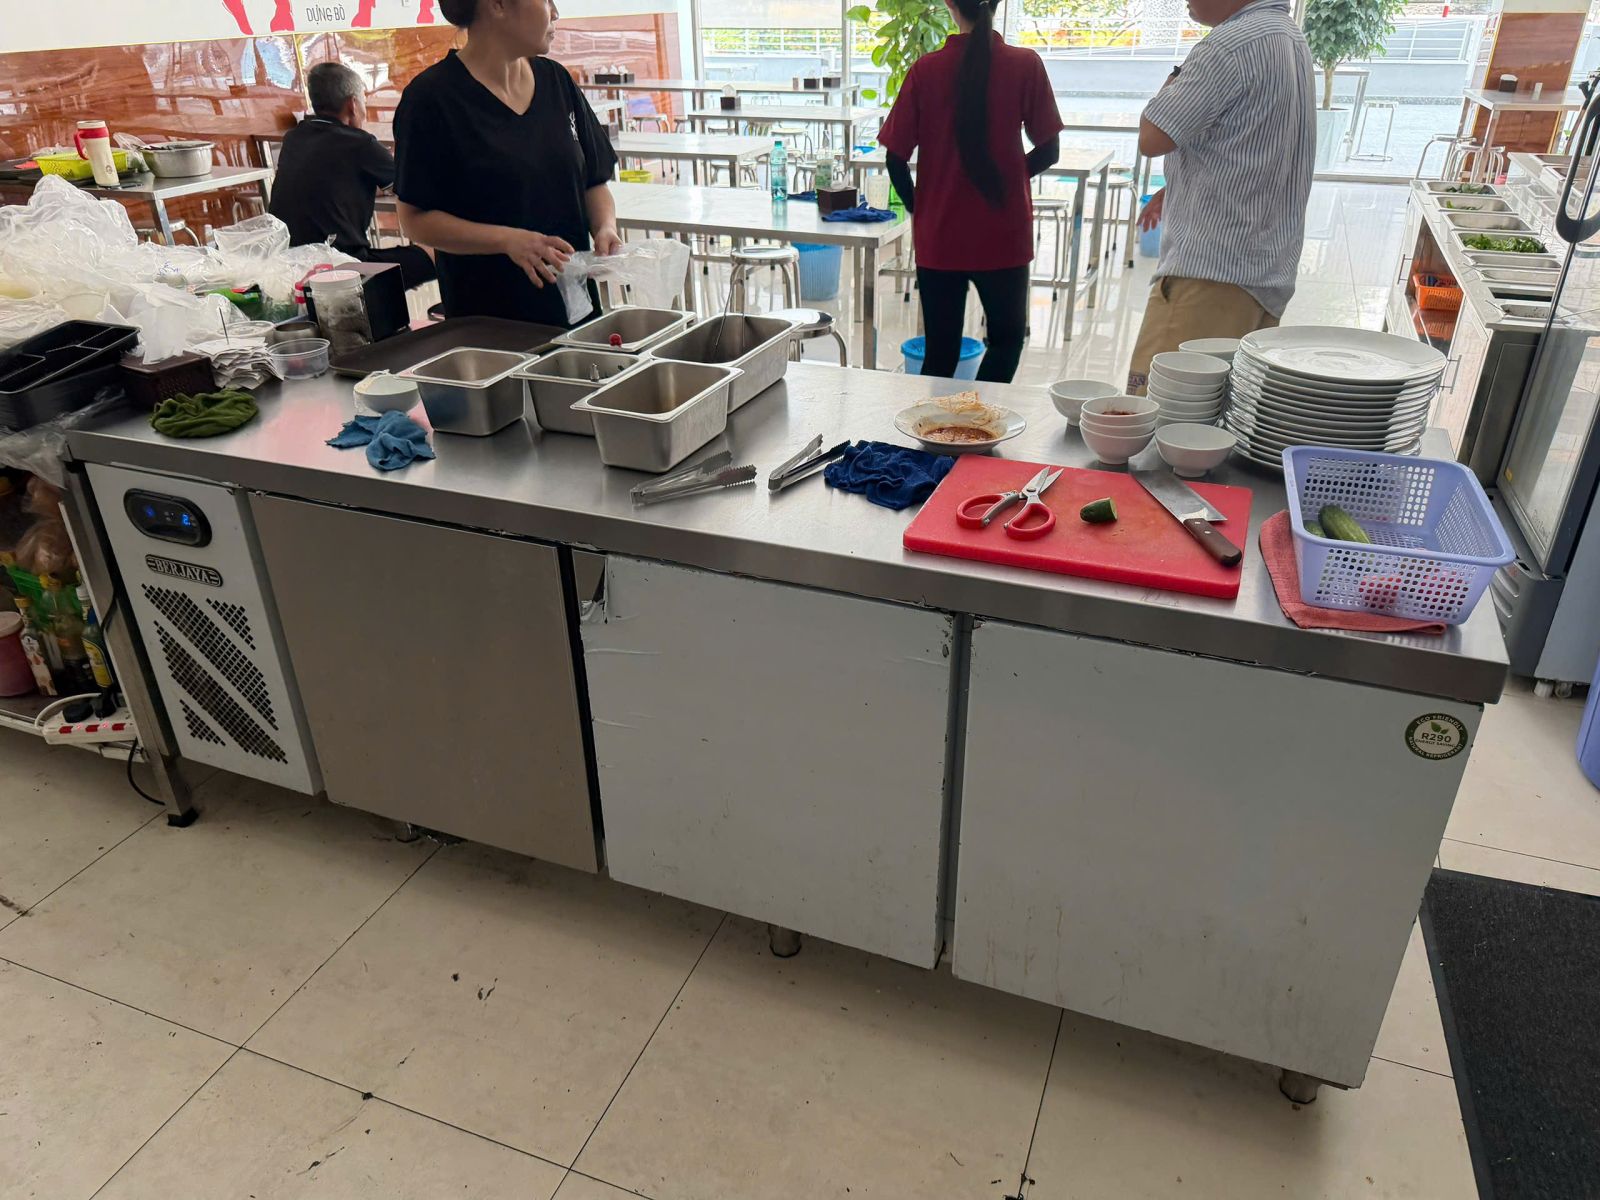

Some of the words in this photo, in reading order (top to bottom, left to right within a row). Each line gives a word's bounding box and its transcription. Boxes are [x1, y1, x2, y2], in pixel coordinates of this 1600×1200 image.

[334, 3, 346, 21] BÒ
[155, 559, 210, 583] BERJAYA
[1416, 716, 1430, 725] ECO
[1433, 715, 1464, 731] FRIENDLY
[1421, 732, 1452, 743] R290
